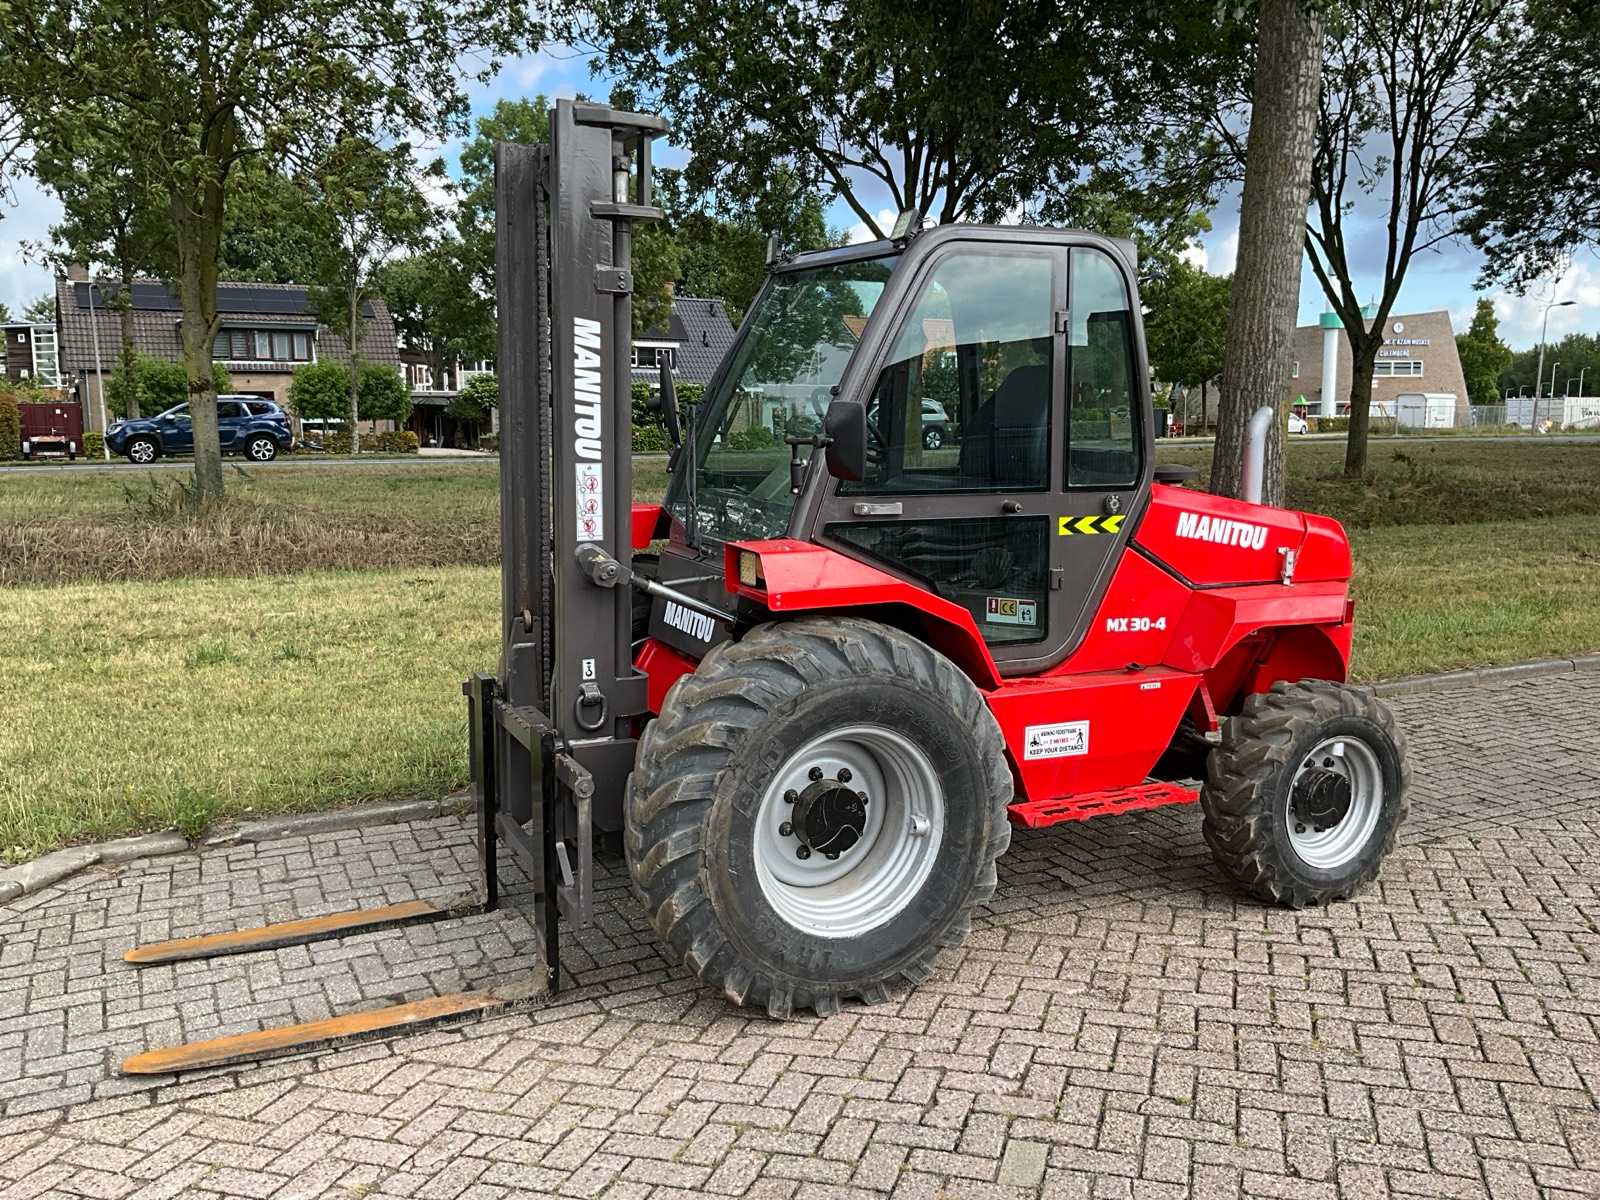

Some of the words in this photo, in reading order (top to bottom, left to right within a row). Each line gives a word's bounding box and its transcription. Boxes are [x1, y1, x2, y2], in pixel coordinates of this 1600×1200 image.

[573, 316, 602, 461] MANITOU
[1175, 511, 1268, 550] MANITOU
[1001, 602, 1015, 613] CE
[663, 600, 716, 643] MANITOU
[1106, 618, 1128, 632] MX
[1130, 617, 1167, 631] 30-4
[1044, 746, 1058, 754] YOUR
[1059, 743, 1084, 753] DISTANCE
